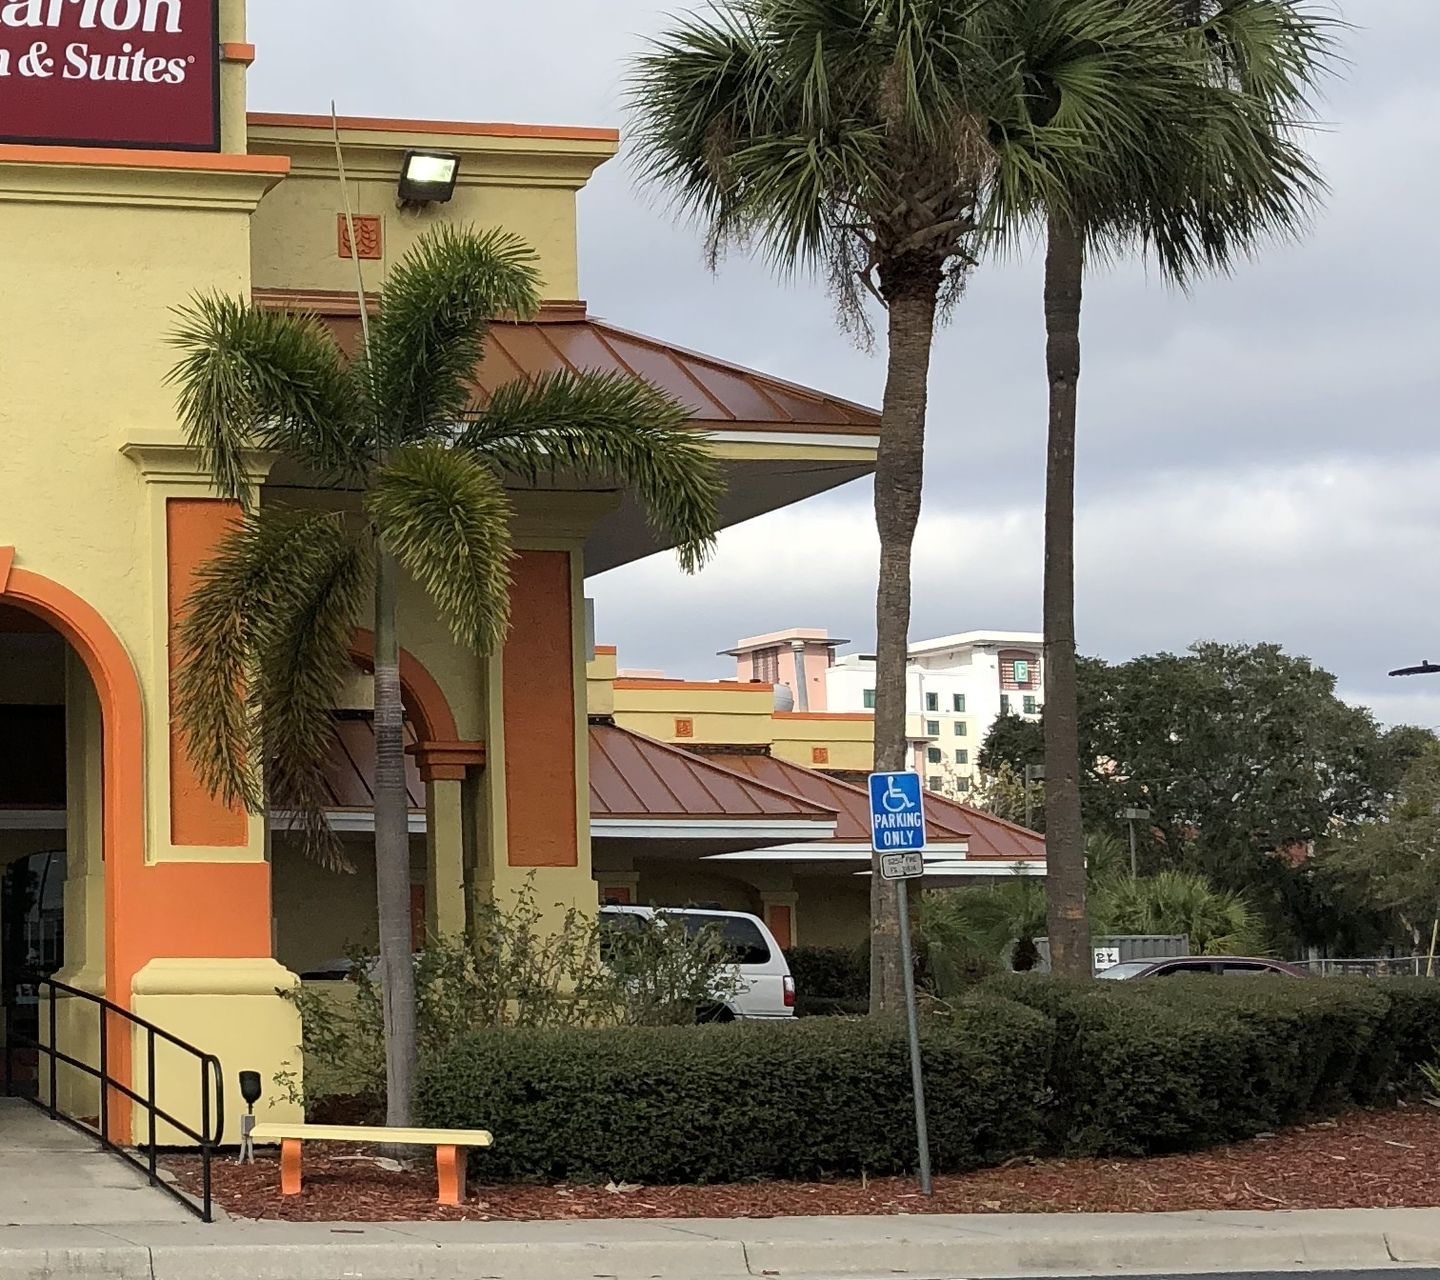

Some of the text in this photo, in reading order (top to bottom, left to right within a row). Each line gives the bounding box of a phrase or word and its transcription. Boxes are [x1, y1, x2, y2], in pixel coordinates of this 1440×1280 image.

[17, 41, 54, 78] &
[874, 812, 921, 828] PARKING
[883, 830, 914, 846] ONLY
